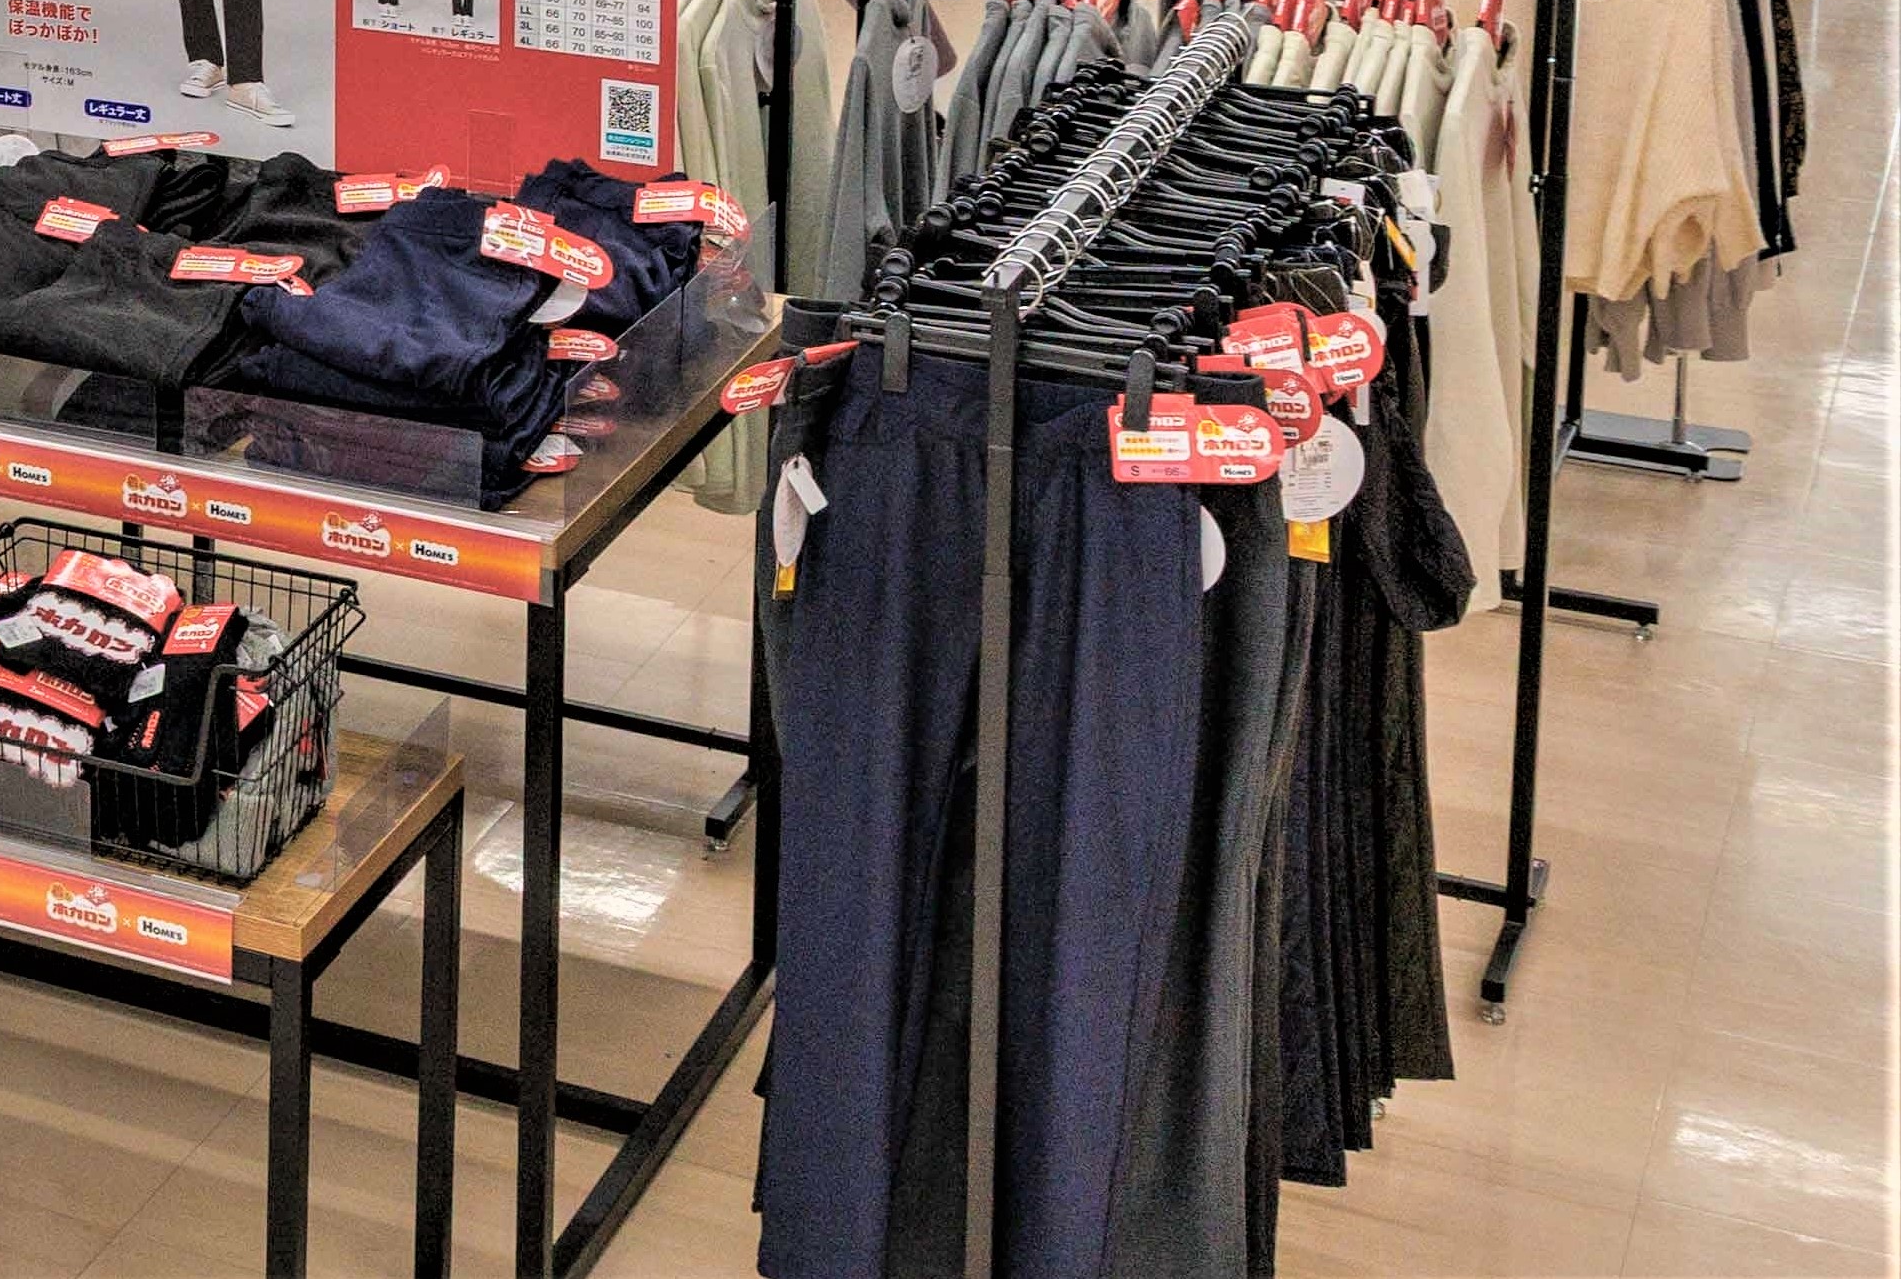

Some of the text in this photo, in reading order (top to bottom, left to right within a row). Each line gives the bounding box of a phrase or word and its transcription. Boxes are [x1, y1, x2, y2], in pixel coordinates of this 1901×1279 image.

[88, 102, 147, 120] レギュラー丈
[127, 493, 184, 513] ホカロン
[328, 530, 386, 552] ホカロン
[52, 903, 113, 927] ホカロン
